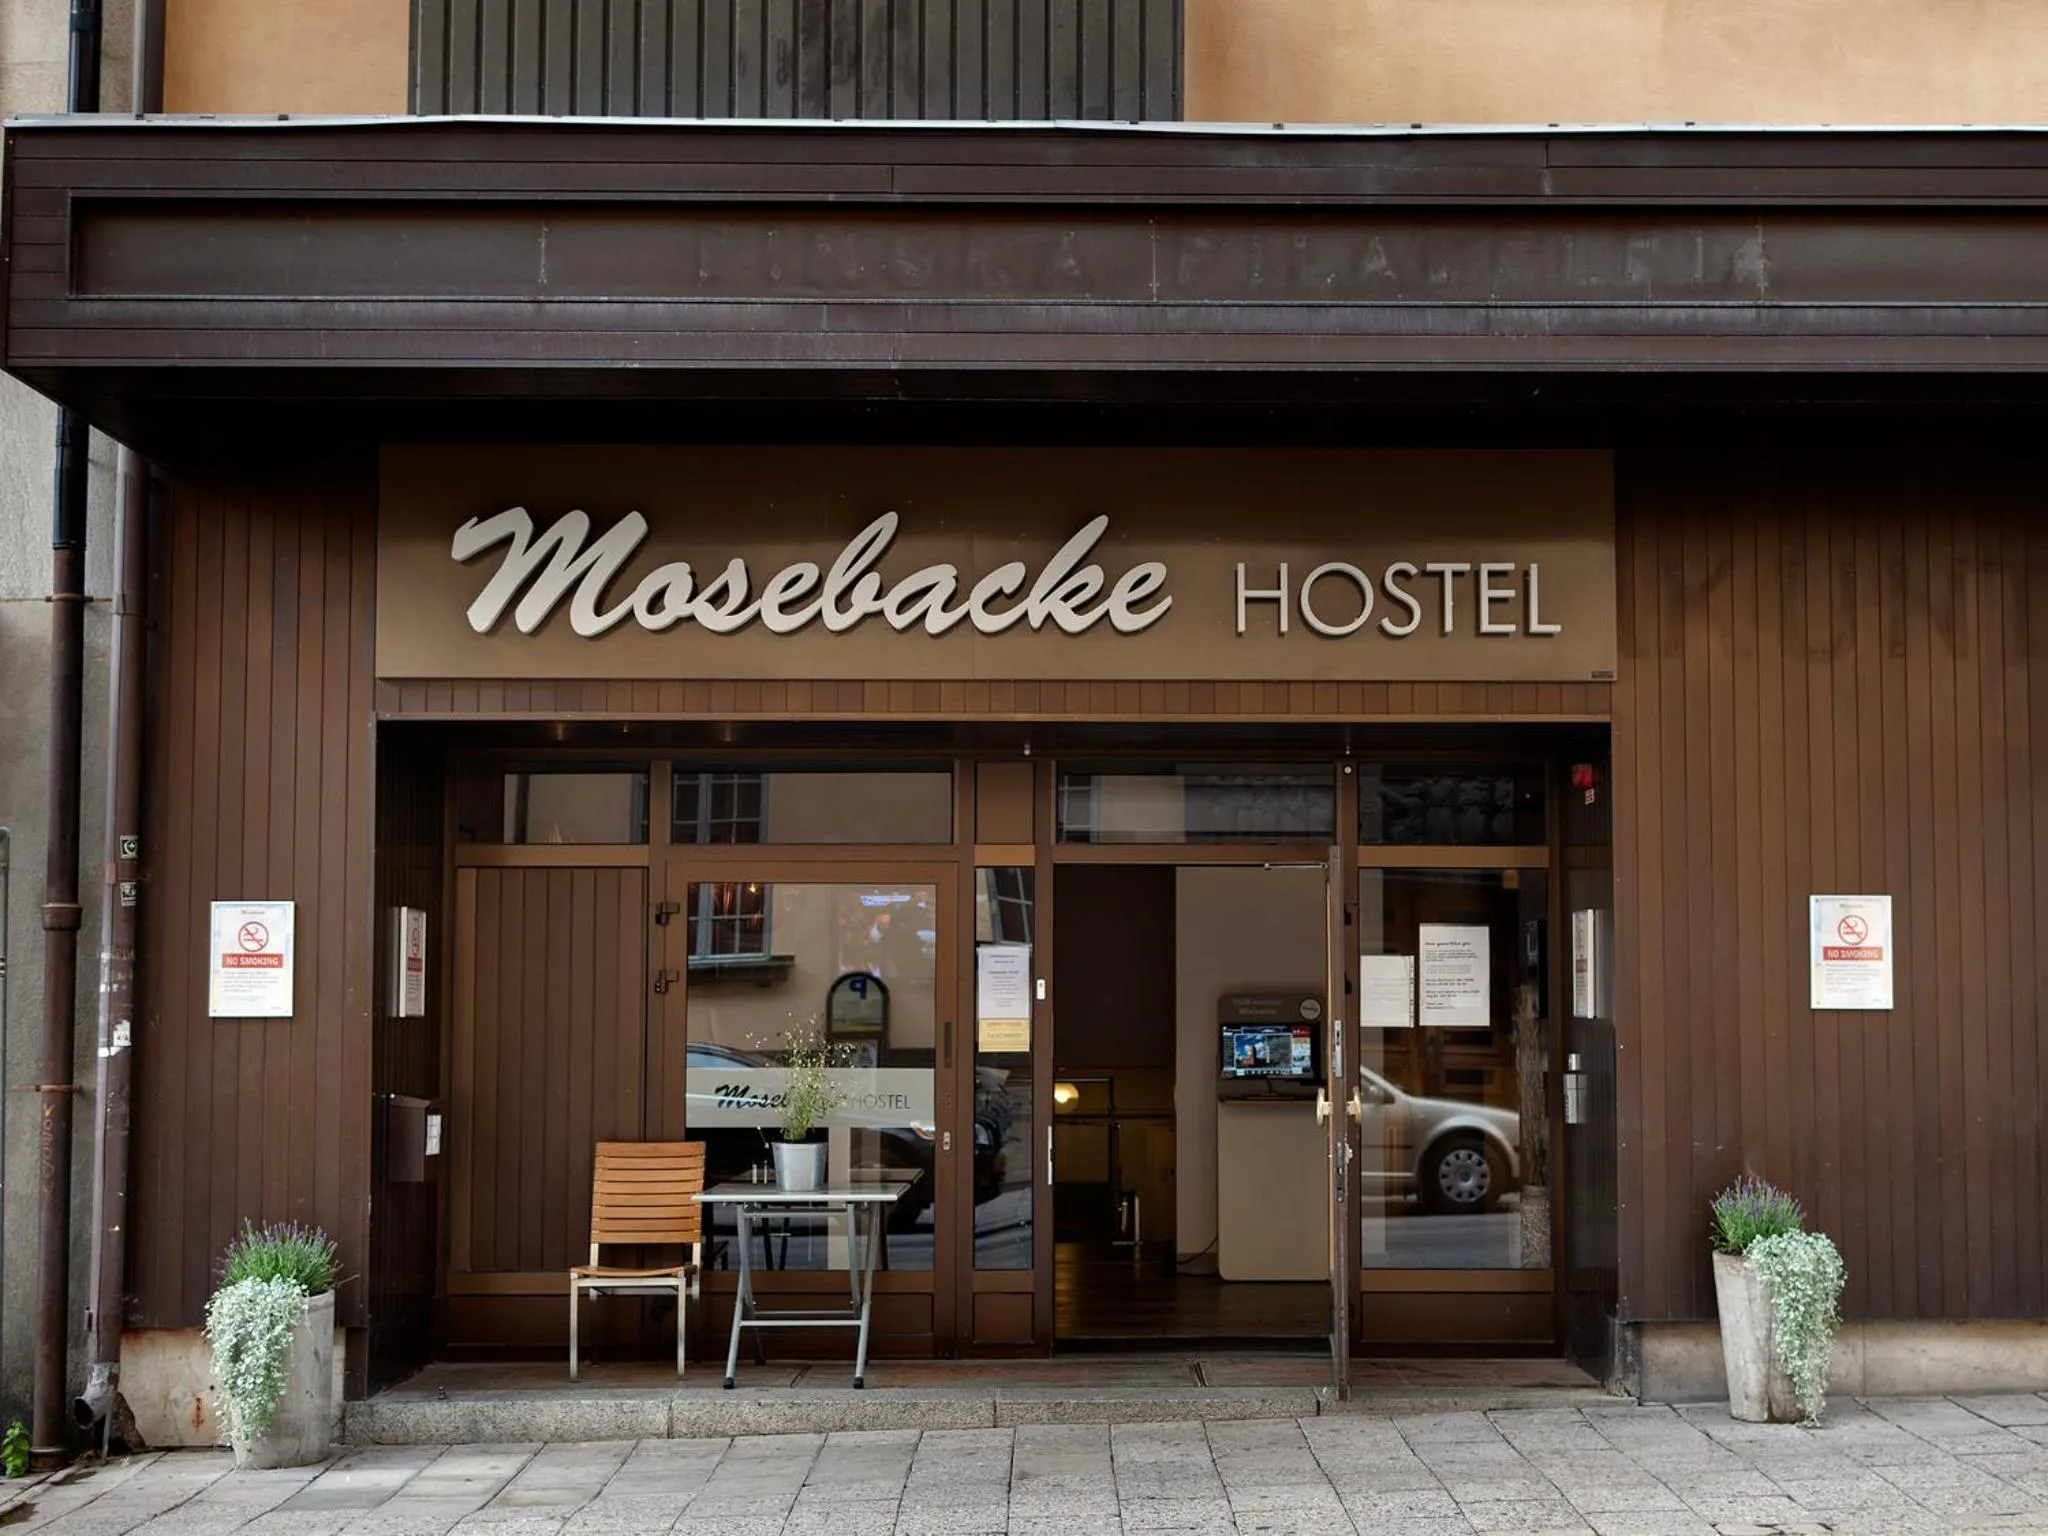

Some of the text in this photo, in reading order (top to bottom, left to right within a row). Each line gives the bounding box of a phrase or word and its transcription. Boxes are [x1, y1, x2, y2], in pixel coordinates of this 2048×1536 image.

[452, 507, 1562, 636] Mosebacke HOSTEL
[226, 957, 279, 966] NO SMOKING
